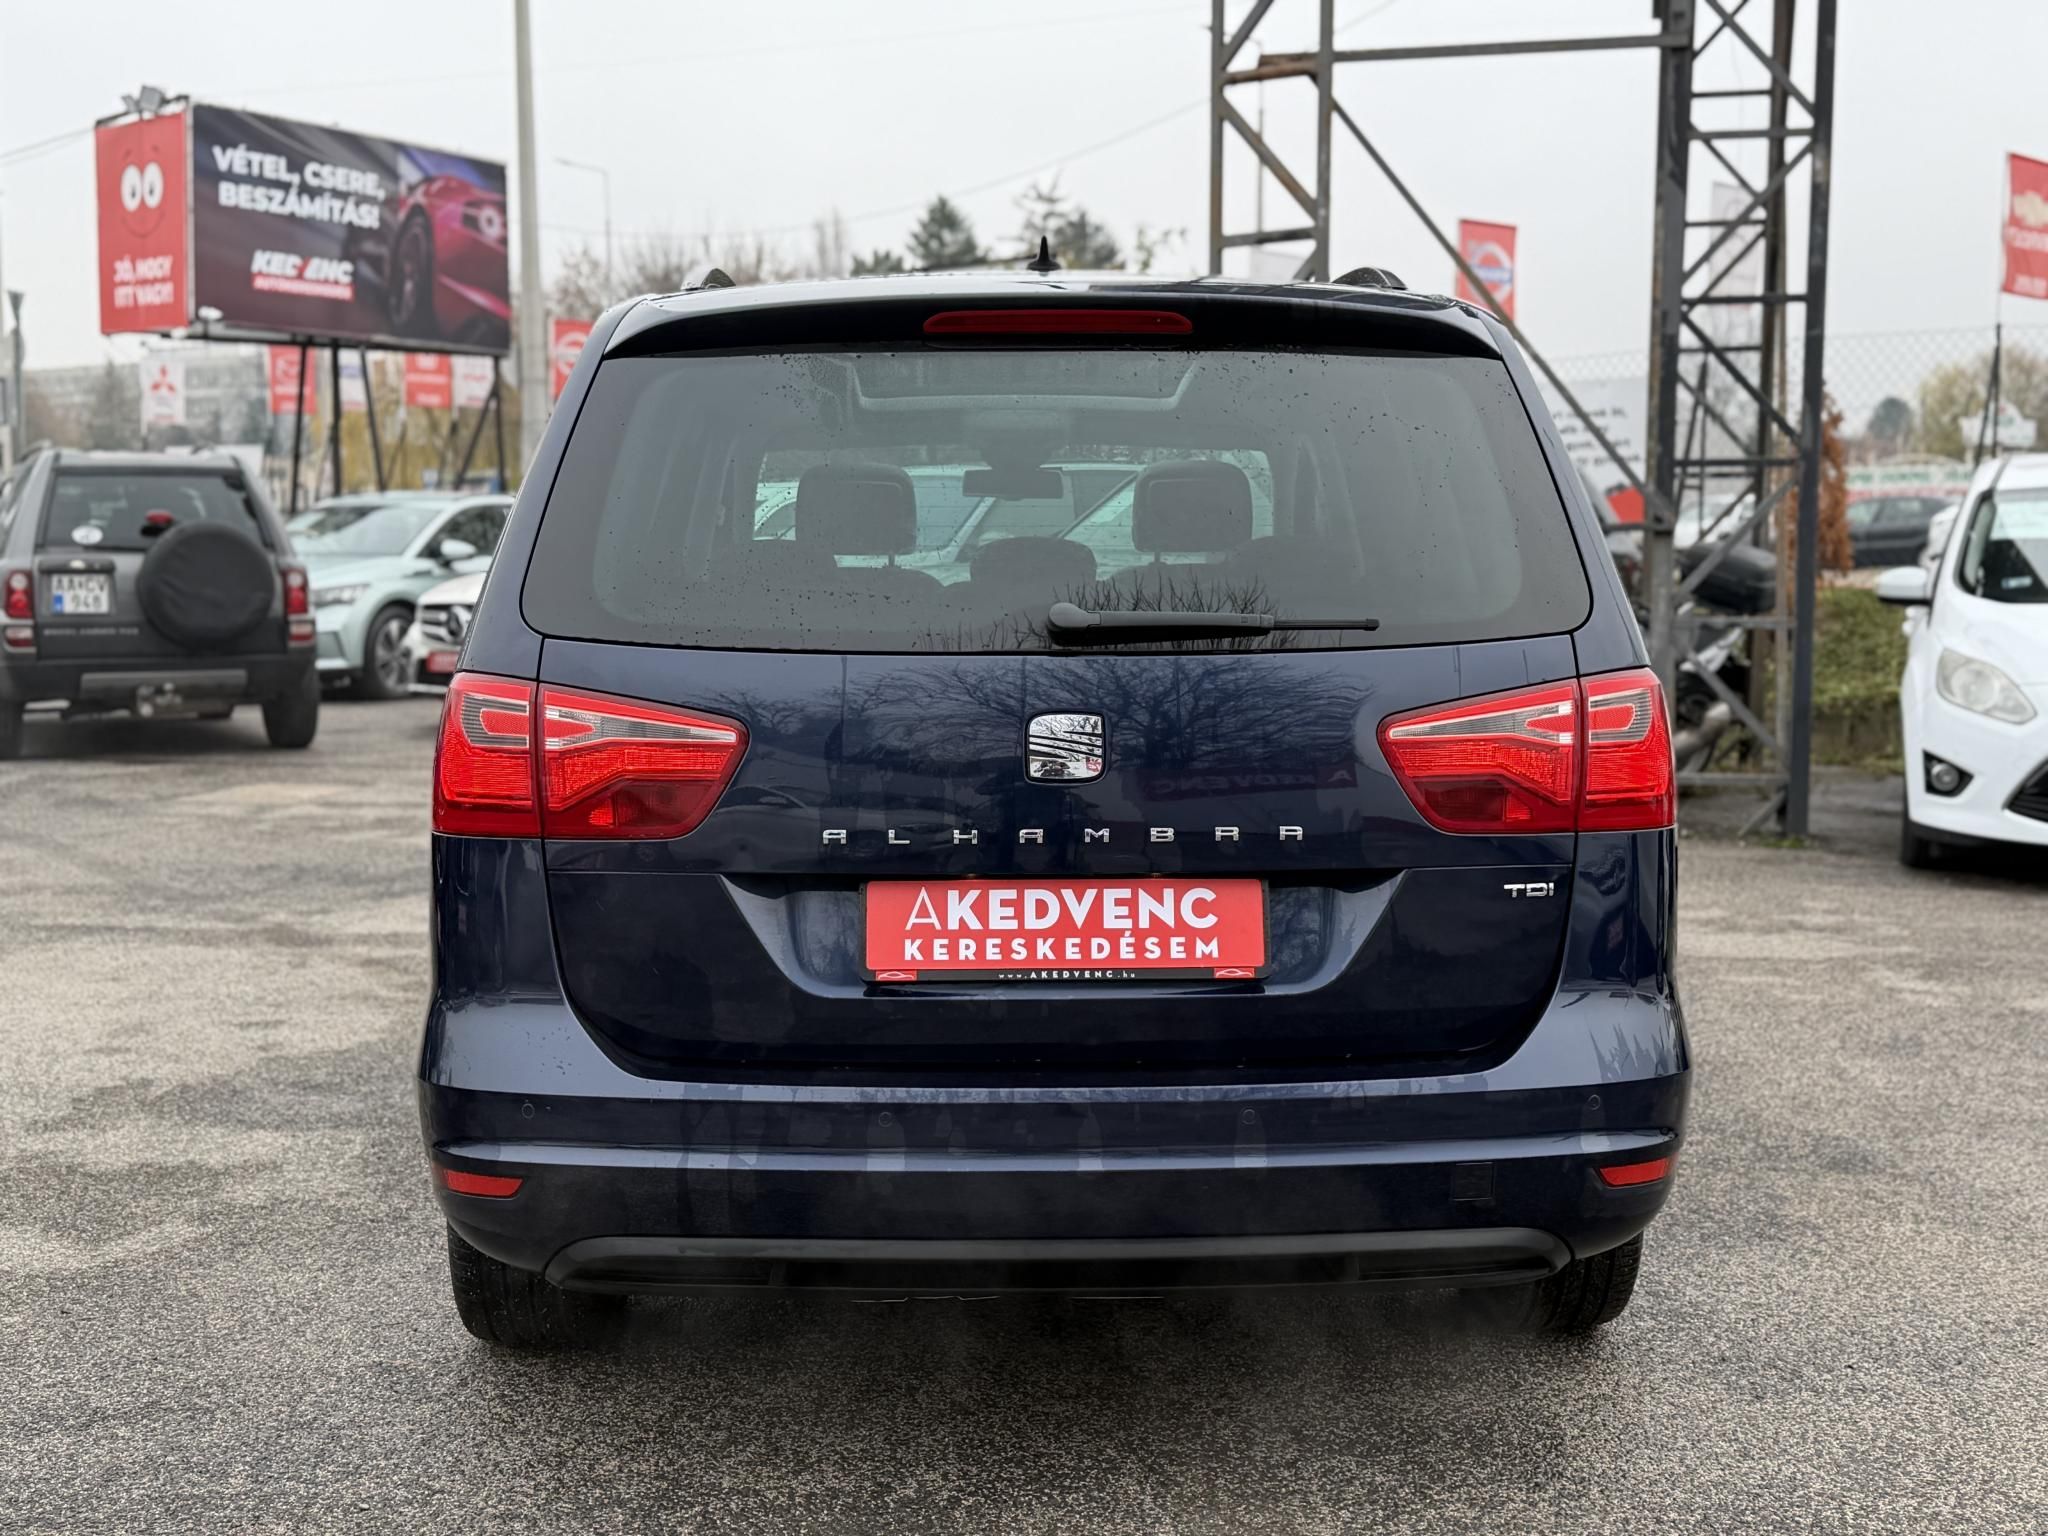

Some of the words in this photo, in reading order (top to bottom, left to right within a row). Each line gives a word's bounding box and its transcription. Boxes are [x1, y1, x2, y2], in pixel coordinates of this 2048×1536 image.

[212, 143, 300, 185] VÉTEL,
[303, 161, 386, 202] CSERE,
[218, 180, 380, 229] BESZÁMÍTÁS!
[136, 255, 173, 281] HOGY
[114, 286, 135, 308] ITT
[822, 825, 1303, 845] ALHAMBRA
[1503, 882, 1554, 898] TDI
[905, 886, 1219, 931] AKEDVENC
[904, 931, 1219, 961] KERESKEDÉSEM
[998, 970, 1136, 980] www.AKEDVENC.hu
